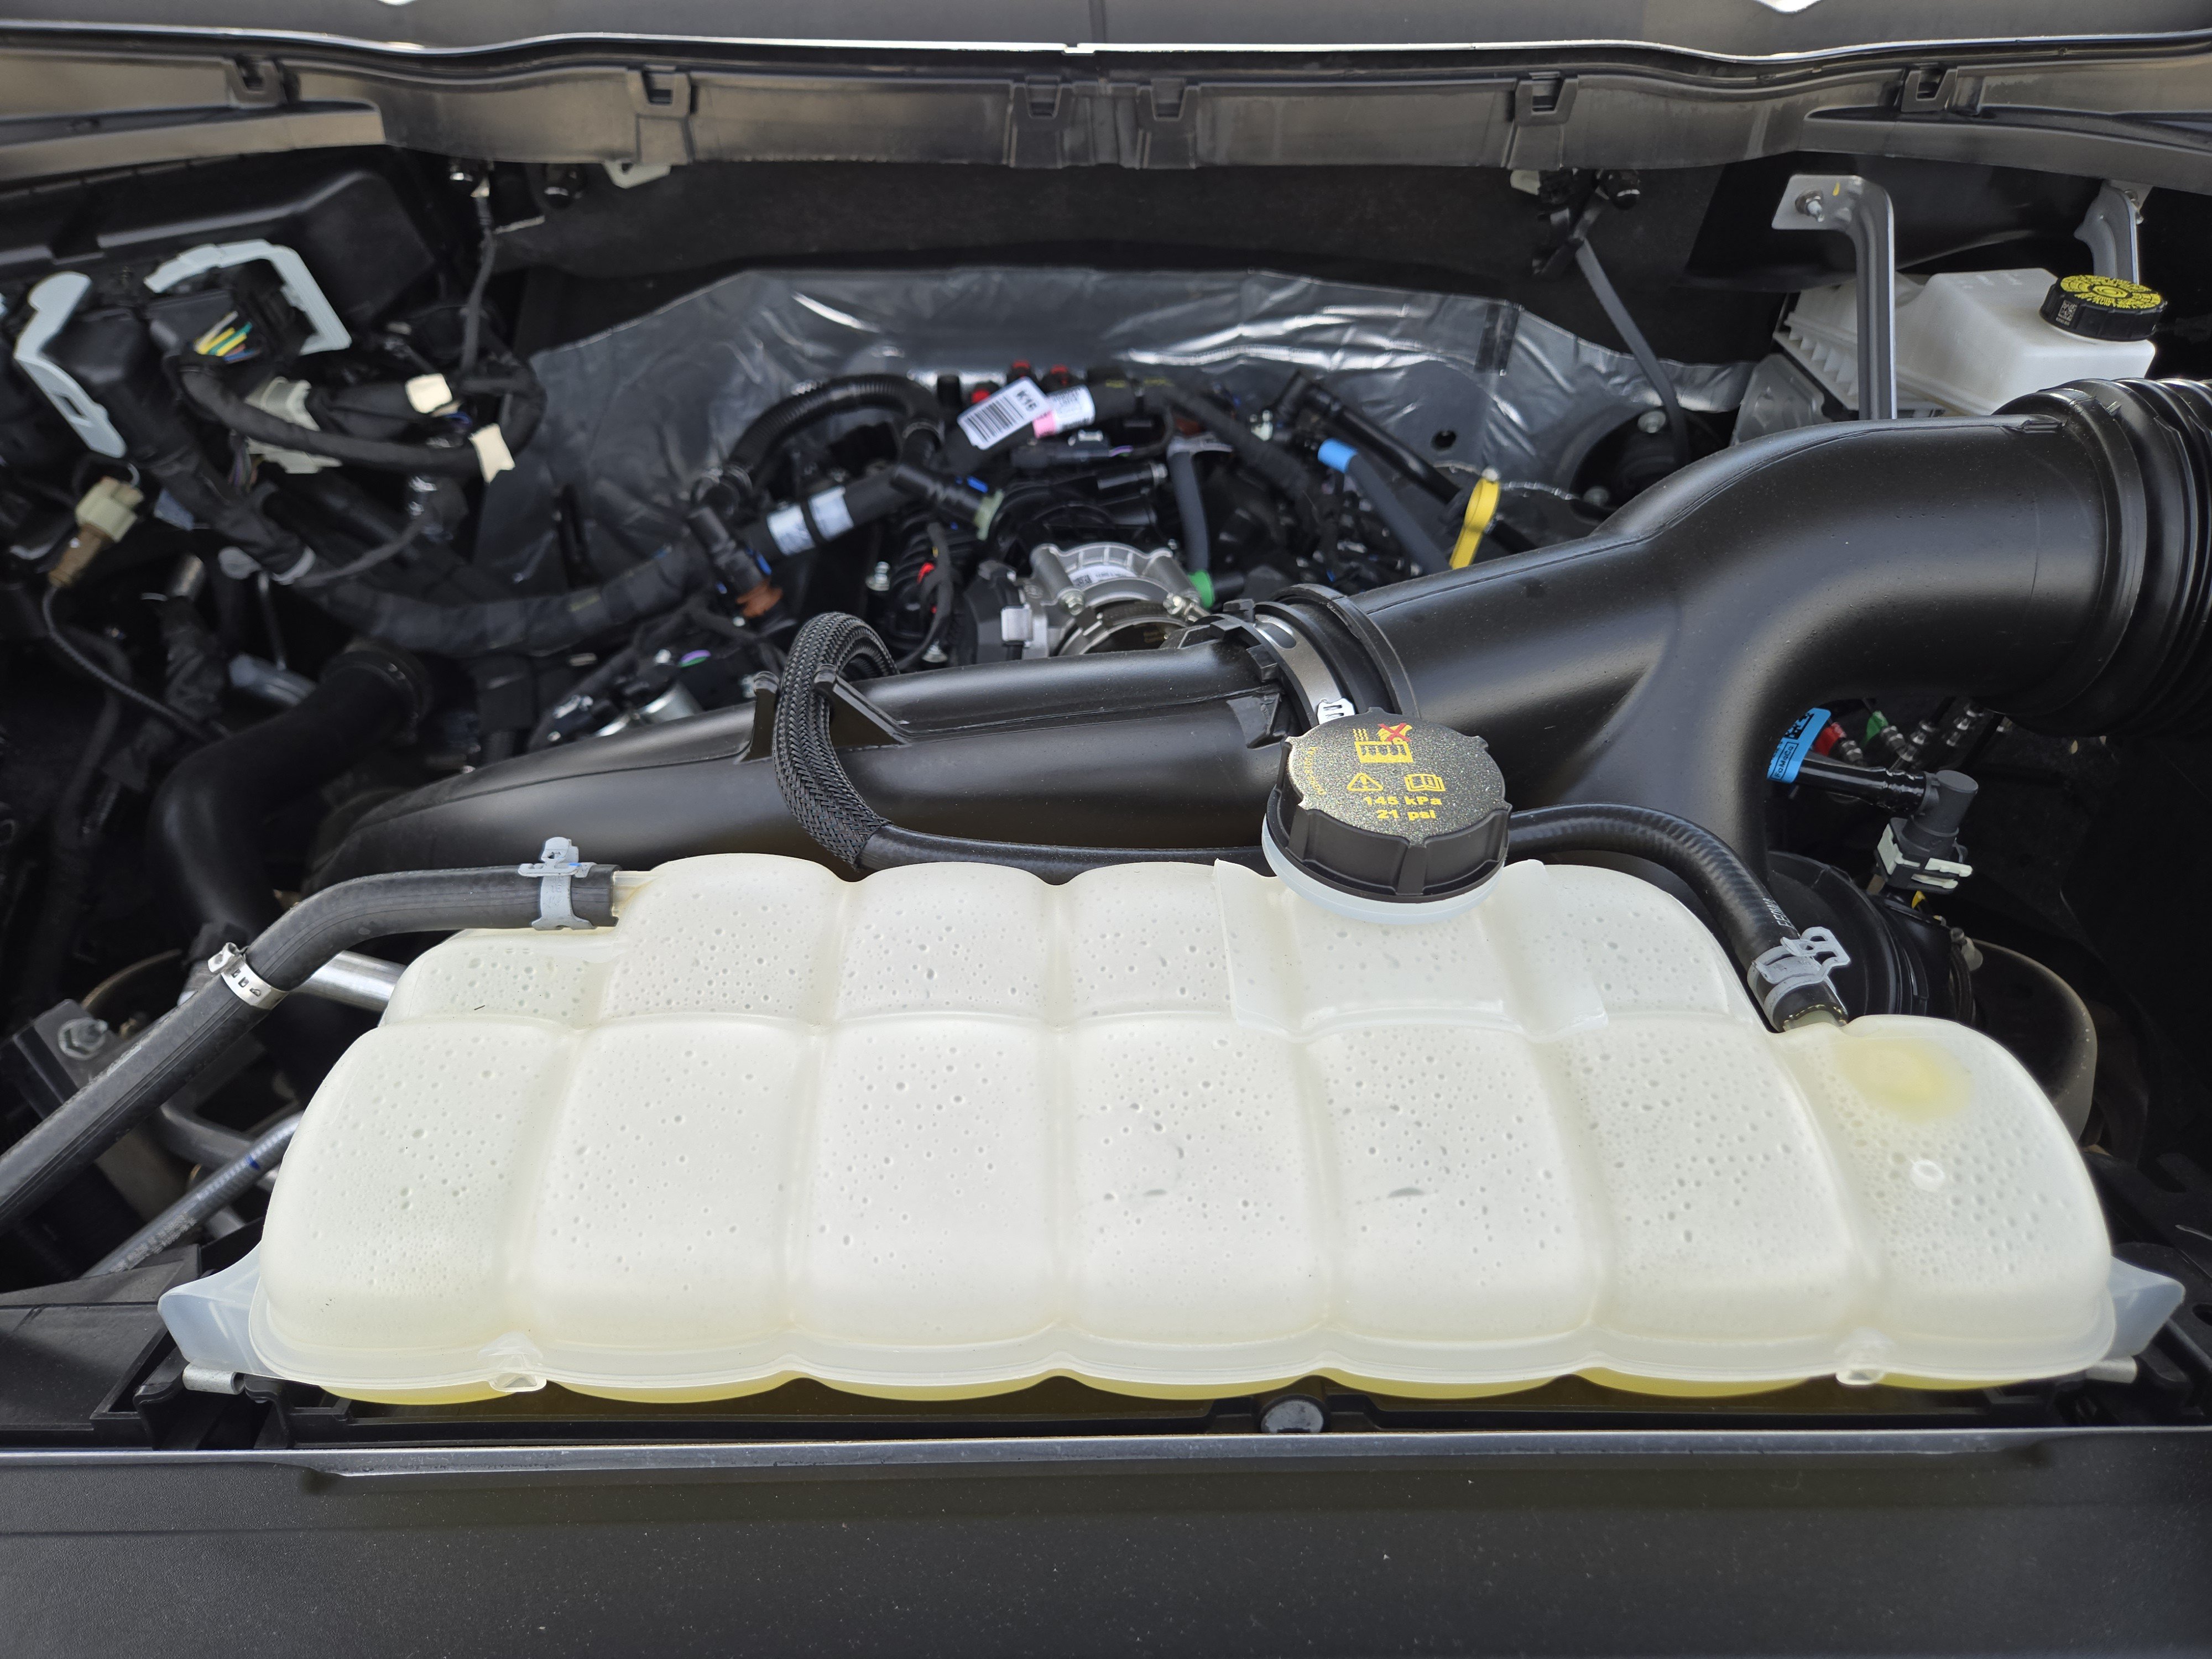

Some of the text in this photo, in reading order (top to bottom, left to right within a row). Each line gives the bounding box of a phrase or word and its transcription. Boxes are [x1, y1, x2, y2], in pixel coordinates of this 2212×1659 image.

[1363, 795, 1442, 805] 145 kPa
[1375, 810, 1436, 821] 21 psi
